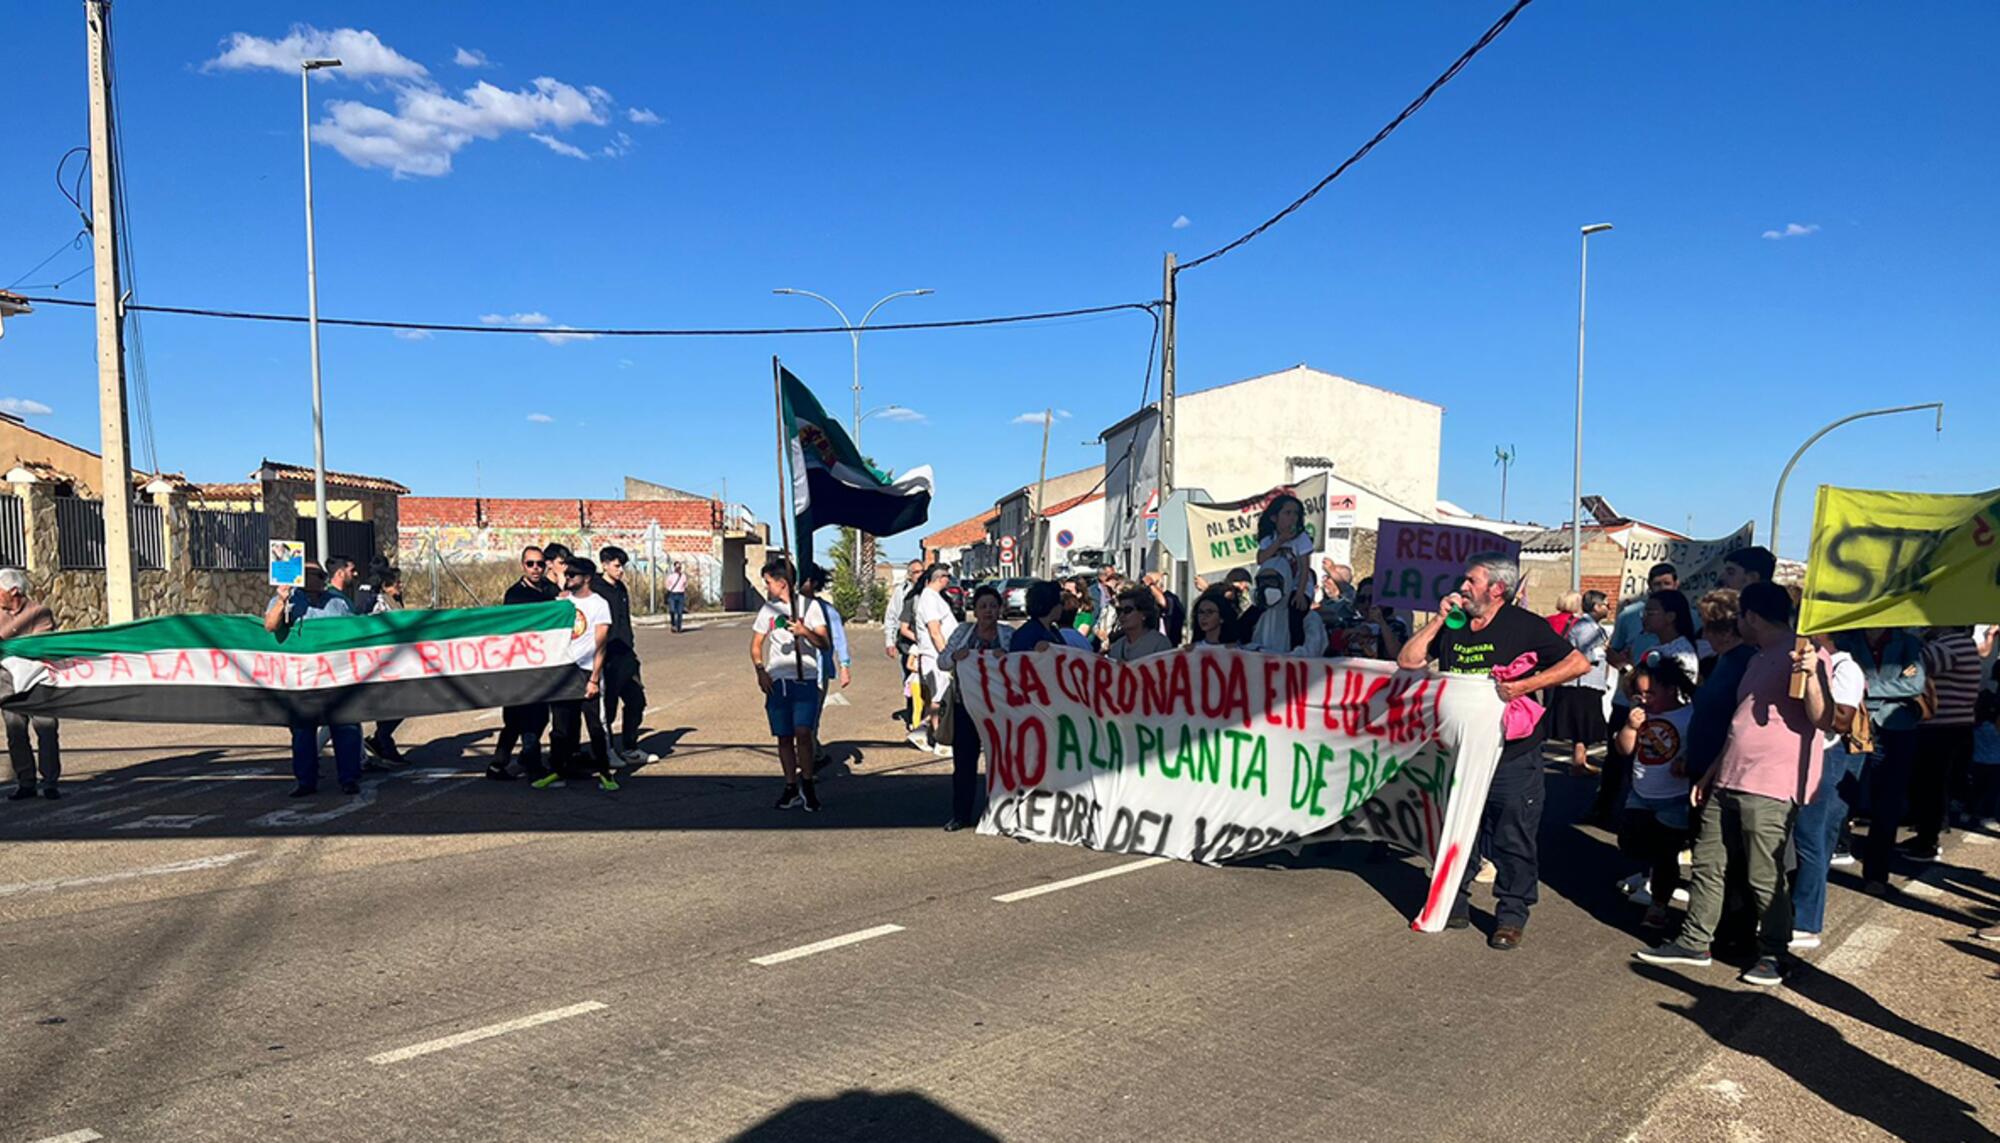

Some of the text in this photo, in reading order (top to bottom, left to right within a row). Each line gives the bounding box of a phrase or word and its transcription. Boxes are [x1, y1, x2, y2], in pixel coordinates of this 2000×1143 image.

[1206, 520, 1224, 538] NI
[1209, 540, 1230, 559] NI
[1381, 567, 1422, 599] LA
[109, 655, 133, 679] A
[145, 650, 195, 681] LA
[208, 648, 337, 688] PLANTA
[350, 647, 400, 683] DE
[416, 633, 547, 675] BIOGAS
[1056, 653, 1251, 728] CORONADA
[1264, 660, 1309, 731] EN
[983, 716, 1047, 793] NO
[1057, 713, 1083, 772] A
[1088, 716, 1124, 774] LA
[1135, 723, 1267, 797] PLANTA
[1290, 741, 1336, 817] DE
